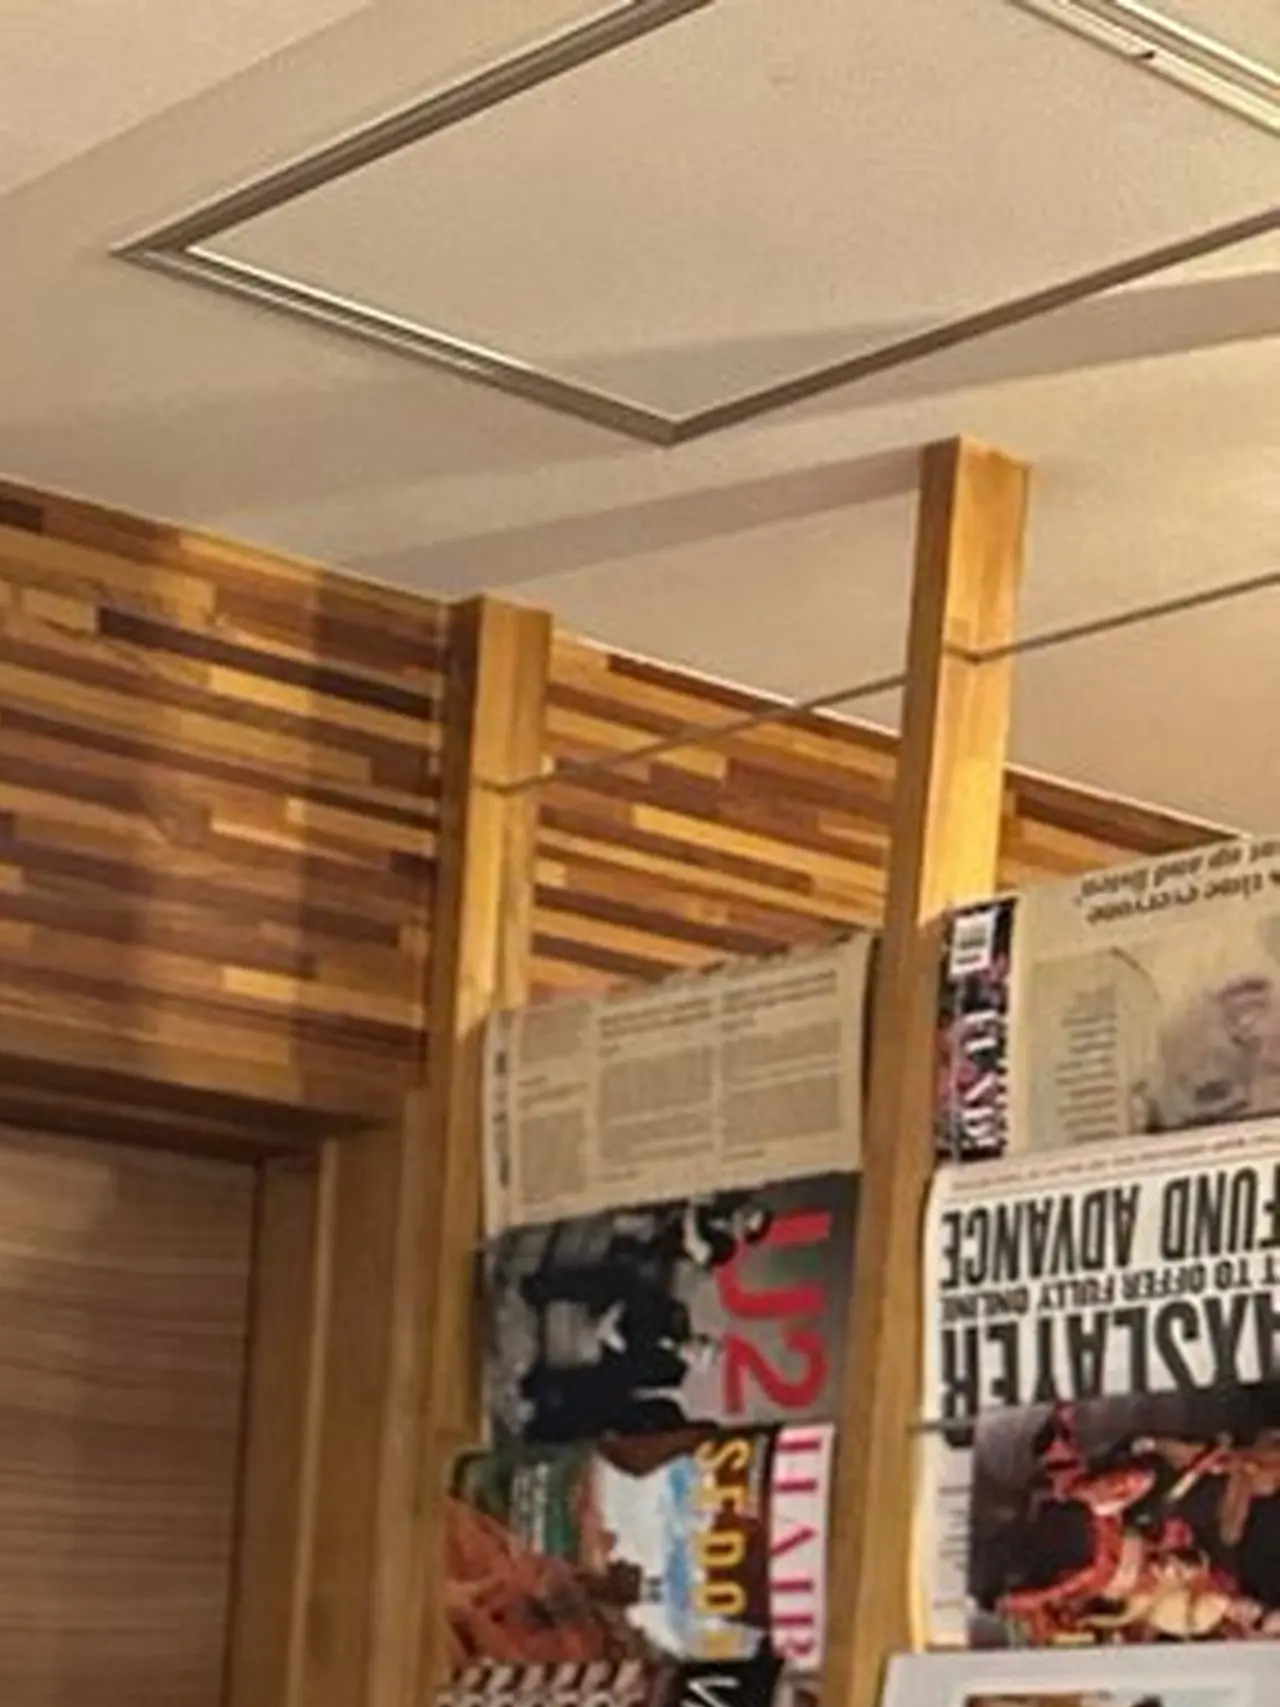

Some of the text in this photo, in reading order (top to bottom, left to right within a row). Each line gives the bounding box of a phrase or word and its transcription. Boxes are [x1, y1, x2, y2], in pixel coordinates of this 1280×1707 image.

[940, 1183, 1142, 1290] ADVANCE
[1122, 1264, 1208, 1300] OFFER
[1215, 1259, 1251, 1290] TO
[1037, 1275, 1116, 1311] FULLY
[715, 1207, 831, 1417] U2
